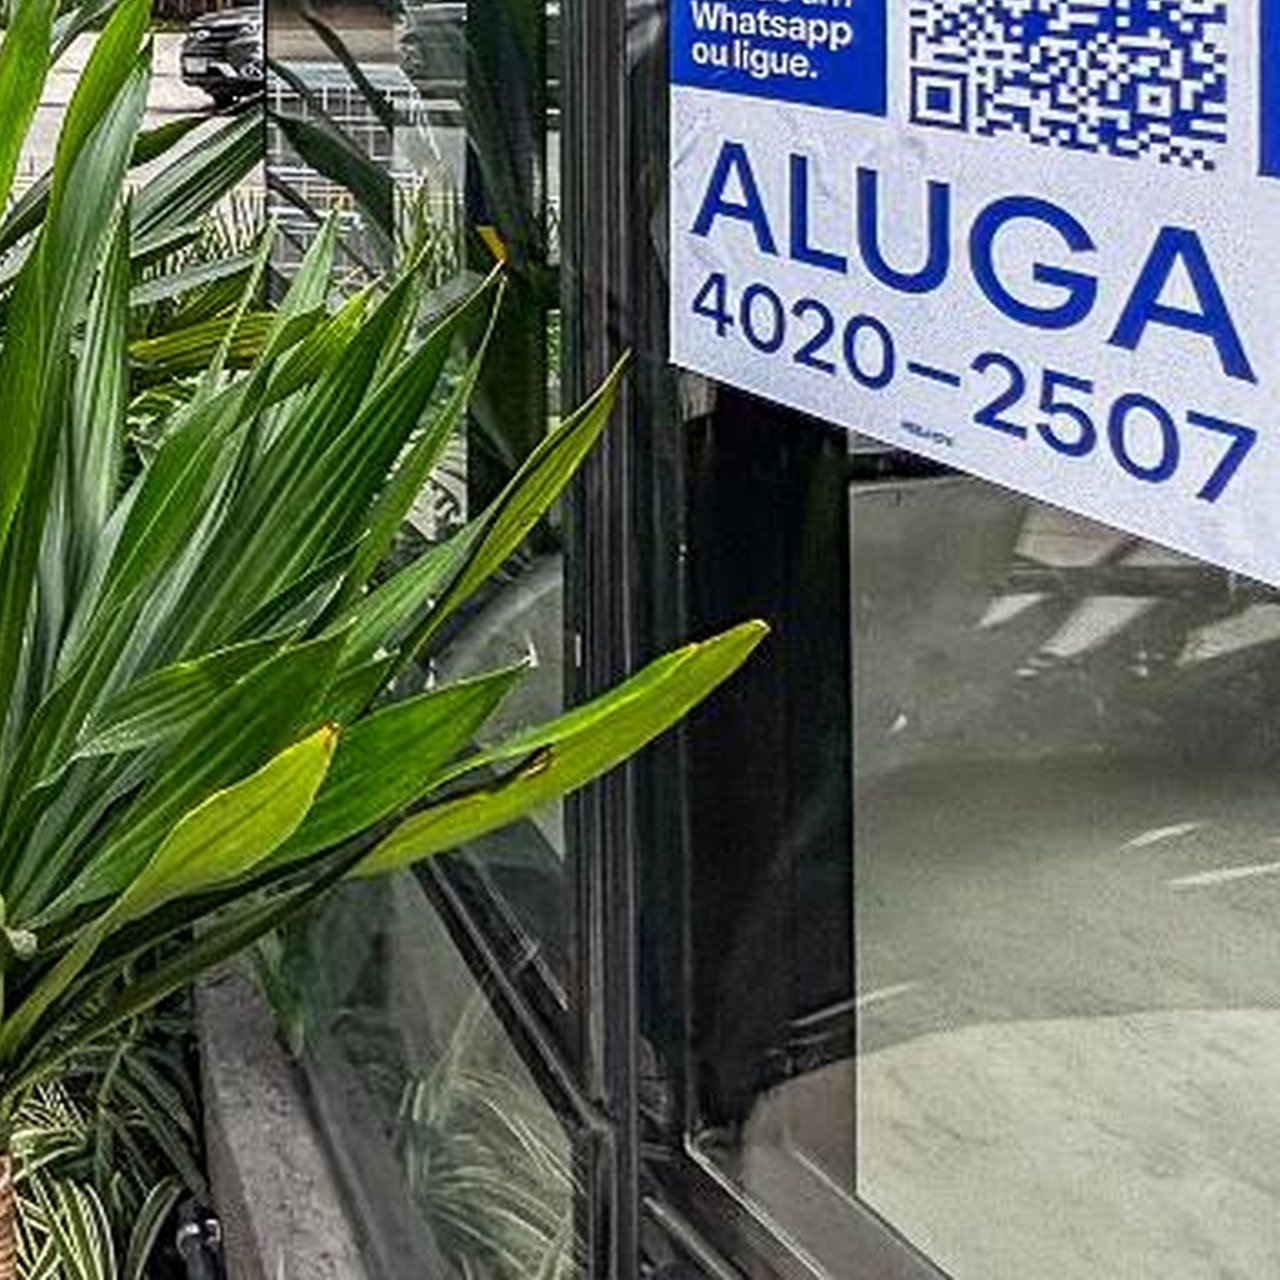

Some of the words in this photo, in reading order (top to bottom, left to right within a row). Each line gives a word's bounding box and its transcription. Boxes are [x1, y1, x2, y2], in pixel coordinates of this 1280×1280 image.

[692, 41, 728, 68] ou
[733, 39, 818, 79] ligue.
[689, 141, 1259, 385] ALUGA
[691, 272, 1259, 504] 4020-2507
